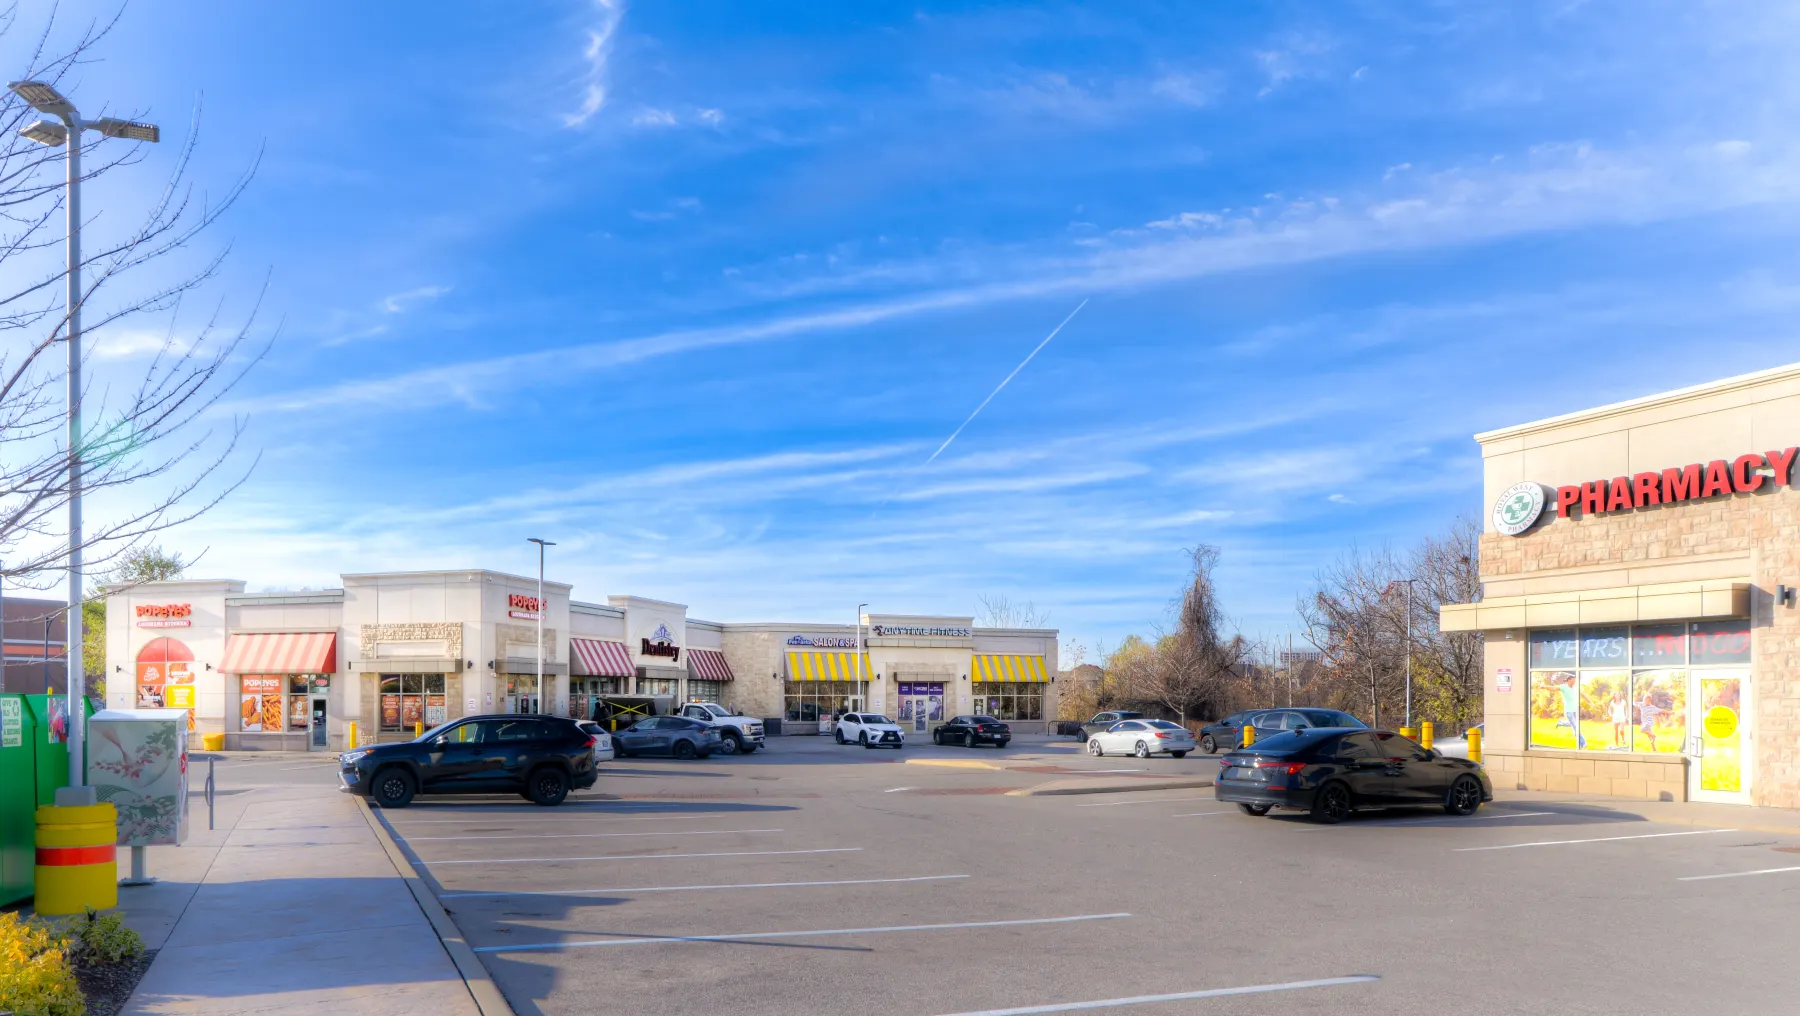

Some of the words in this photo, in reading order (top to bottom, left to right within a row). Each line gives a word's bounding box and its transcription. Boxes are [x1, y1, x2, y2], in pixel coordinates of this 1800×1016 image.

[1556, 446, 1800, 518] PHARMACY
[1496, 490, 1512, 514] ROYAL
[1512, 484, 1533, 492] WEST
[1507, 500, 1541, 533] PHARMACY
[136, 603, 191, 618] POPEYES
[884, 627, 930, 636] ANYTIME
[930, 627, 970, 637] FITNESS
[641, 638, 680, 662] Dentistry
[813, 637, 838, 648] SALON
[838, 639, 846, 648] &
[845, 638, 859, 648] SPA
[243, 679, 280, 687] POPEYES
